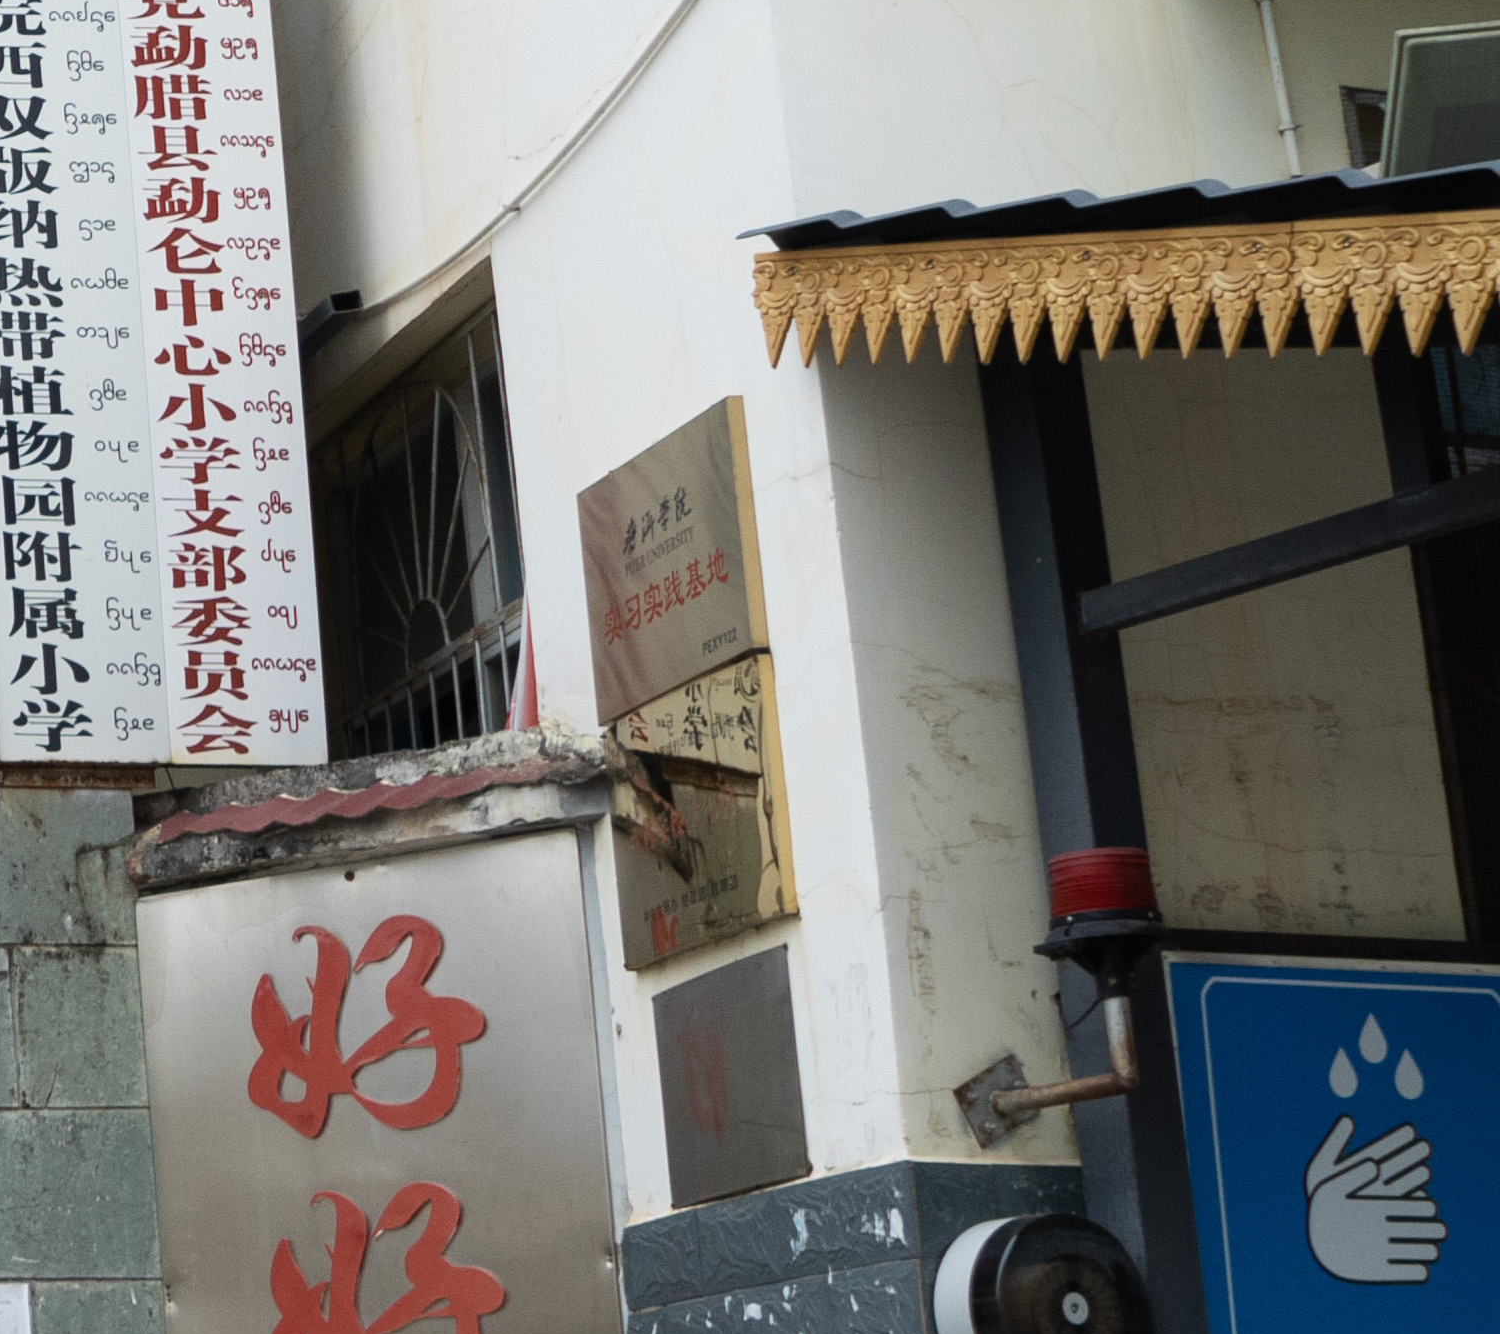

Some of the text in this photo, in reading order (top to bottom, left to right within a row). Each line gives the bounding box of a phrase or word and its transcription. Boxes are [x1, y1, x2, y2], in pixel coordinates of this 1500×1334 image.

[604, 547, 729, 646] 实习实践基地
